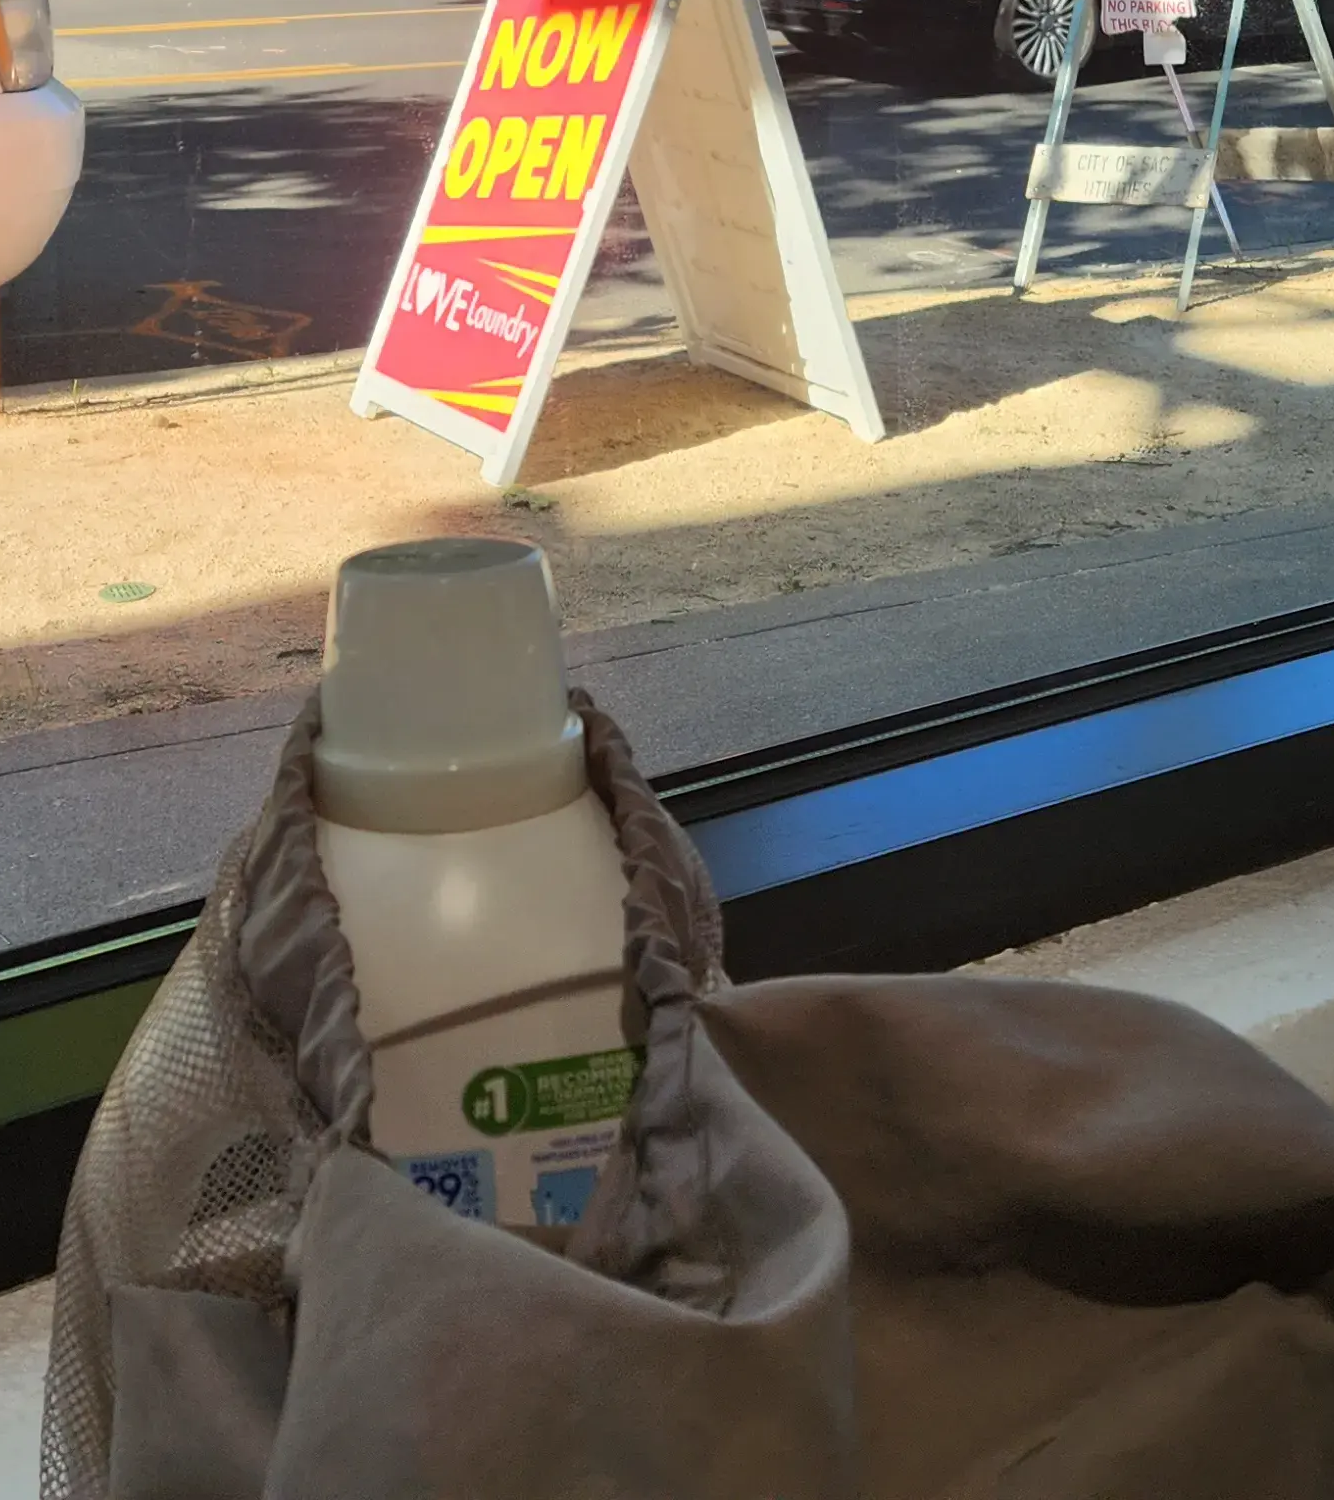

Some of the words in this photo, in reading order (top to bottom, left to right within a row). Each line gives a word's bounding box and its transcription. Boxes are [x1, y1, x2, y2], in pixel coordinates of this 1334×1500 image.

[1107, 0, 1127, 13] NO
[1130, 0, 1186, 14] PARKING
[1110, 18, 1140, 31] THIS
[479, 3, 641, 92] NOW
[442, 114, 607, 200] OPEN
[1077, 153, 1109, 172] CITY
[1115, 155, 1136, 172] OF
[1141, 155, 1170, 173] SAC
[1084, 179, 1152, 200] UTILITIES
[472, 1076, 509, 1124] #1
